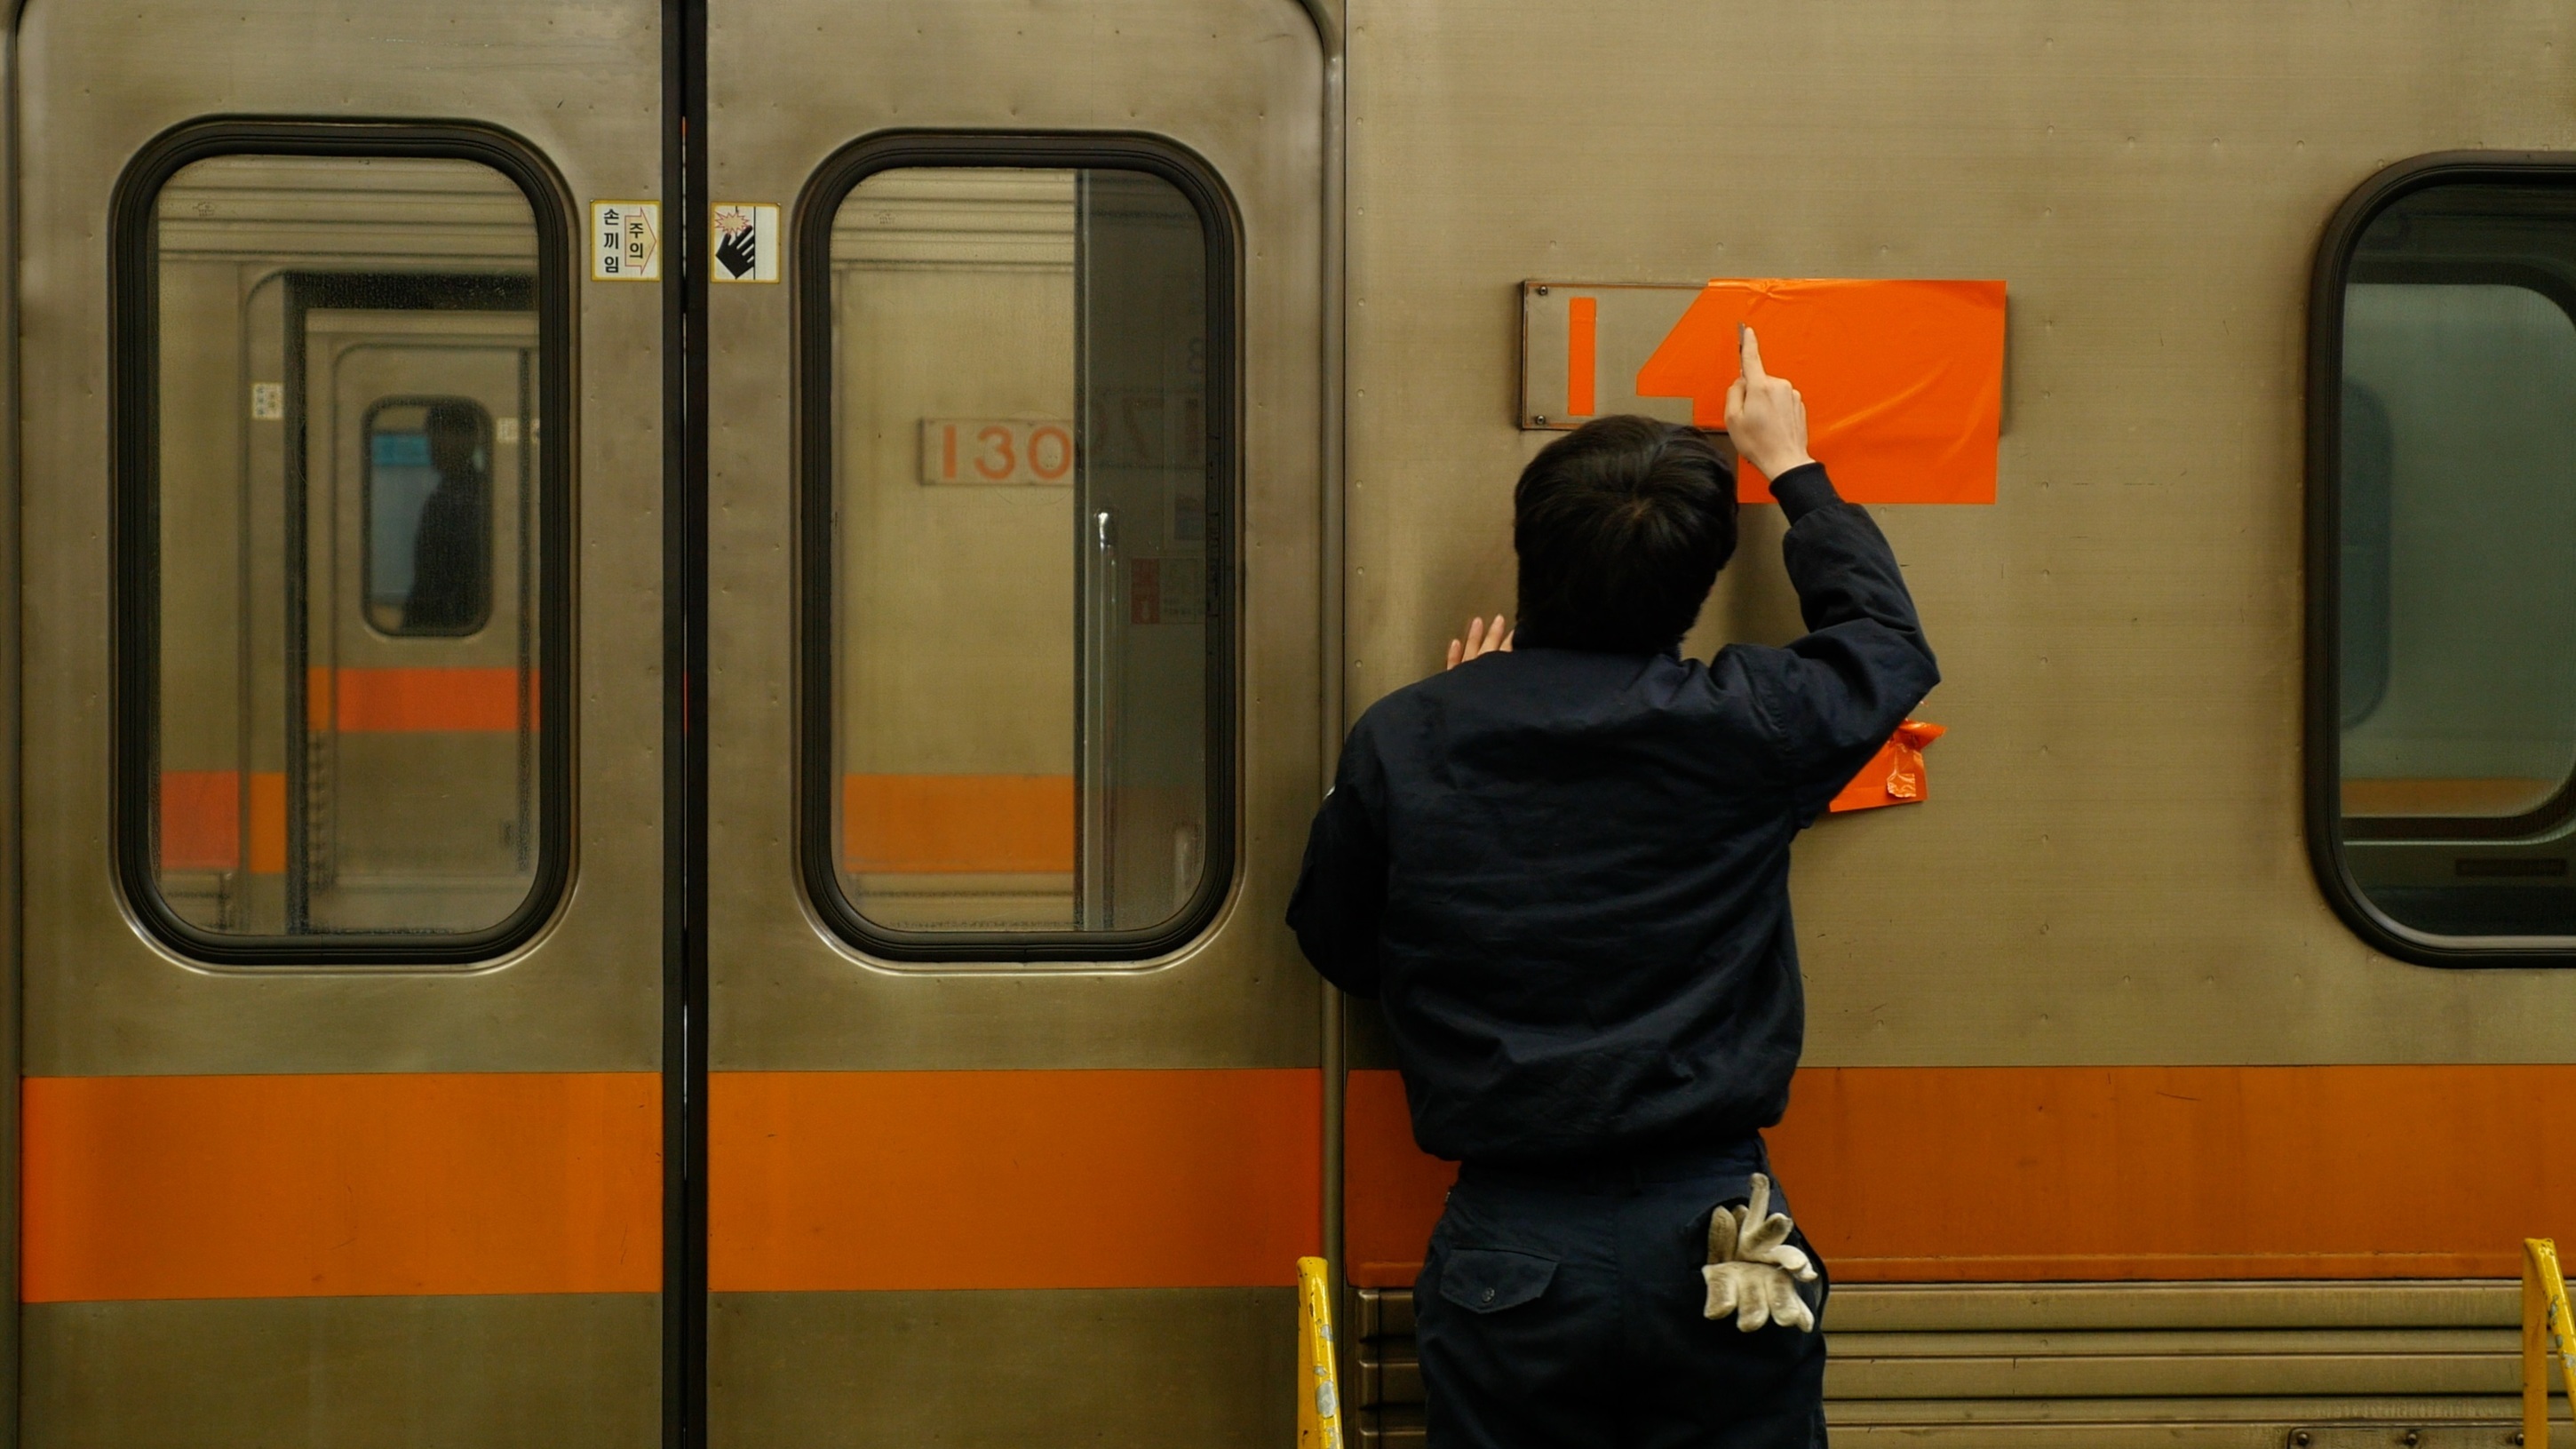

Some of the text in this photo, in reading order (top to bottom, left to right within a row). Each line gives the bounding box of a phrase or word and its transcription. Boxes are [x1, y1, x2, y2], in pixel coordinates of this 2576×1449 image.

[603, 208, 620, 274] 손끼임
[629, 222, 644, 259] 주의
[942, 424, 1073, 481] 130
